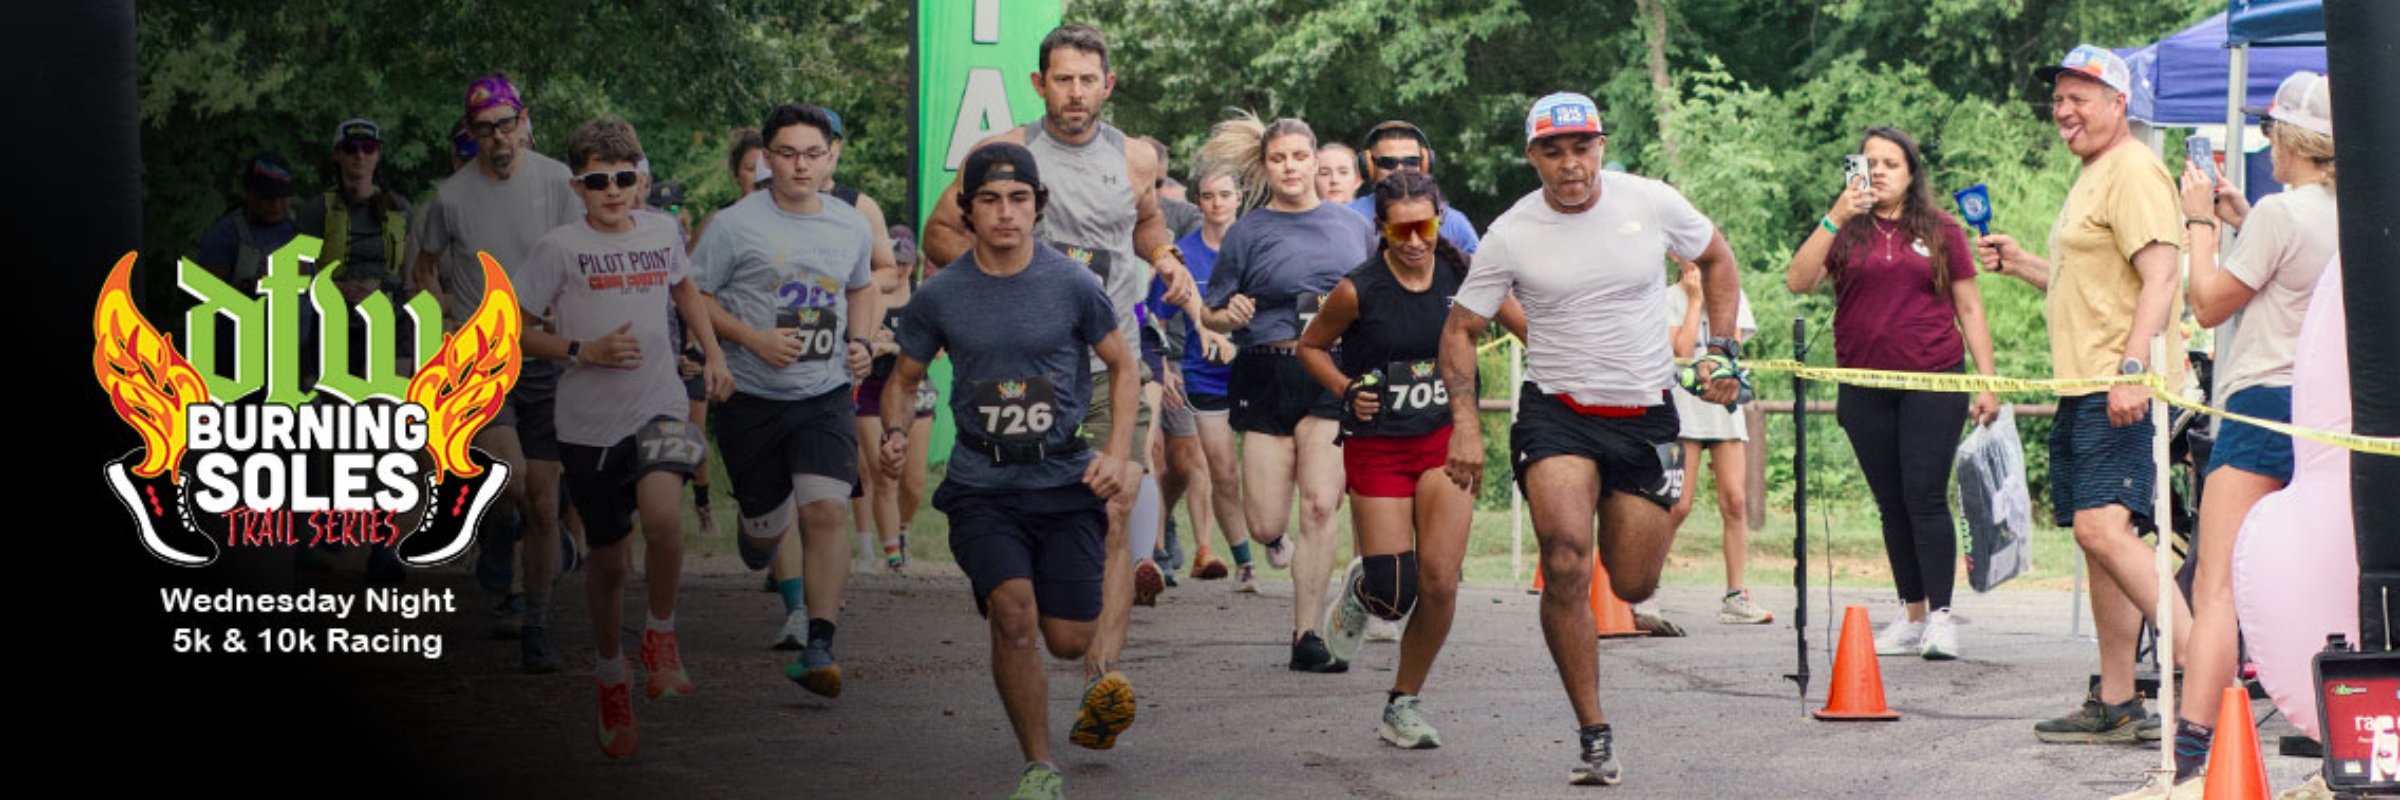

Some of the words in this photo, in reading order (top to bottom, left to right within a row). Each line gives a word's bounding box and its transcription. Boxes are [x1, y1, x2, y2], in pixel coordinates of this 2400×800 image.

[578, 251, 625, 276] PILOT
[627, 246, 672, 272] POINT
[1388, 379, 1450, 411] 705
[978, 401, 1054, 435] 726
[641, 437, 703, 465] 727
